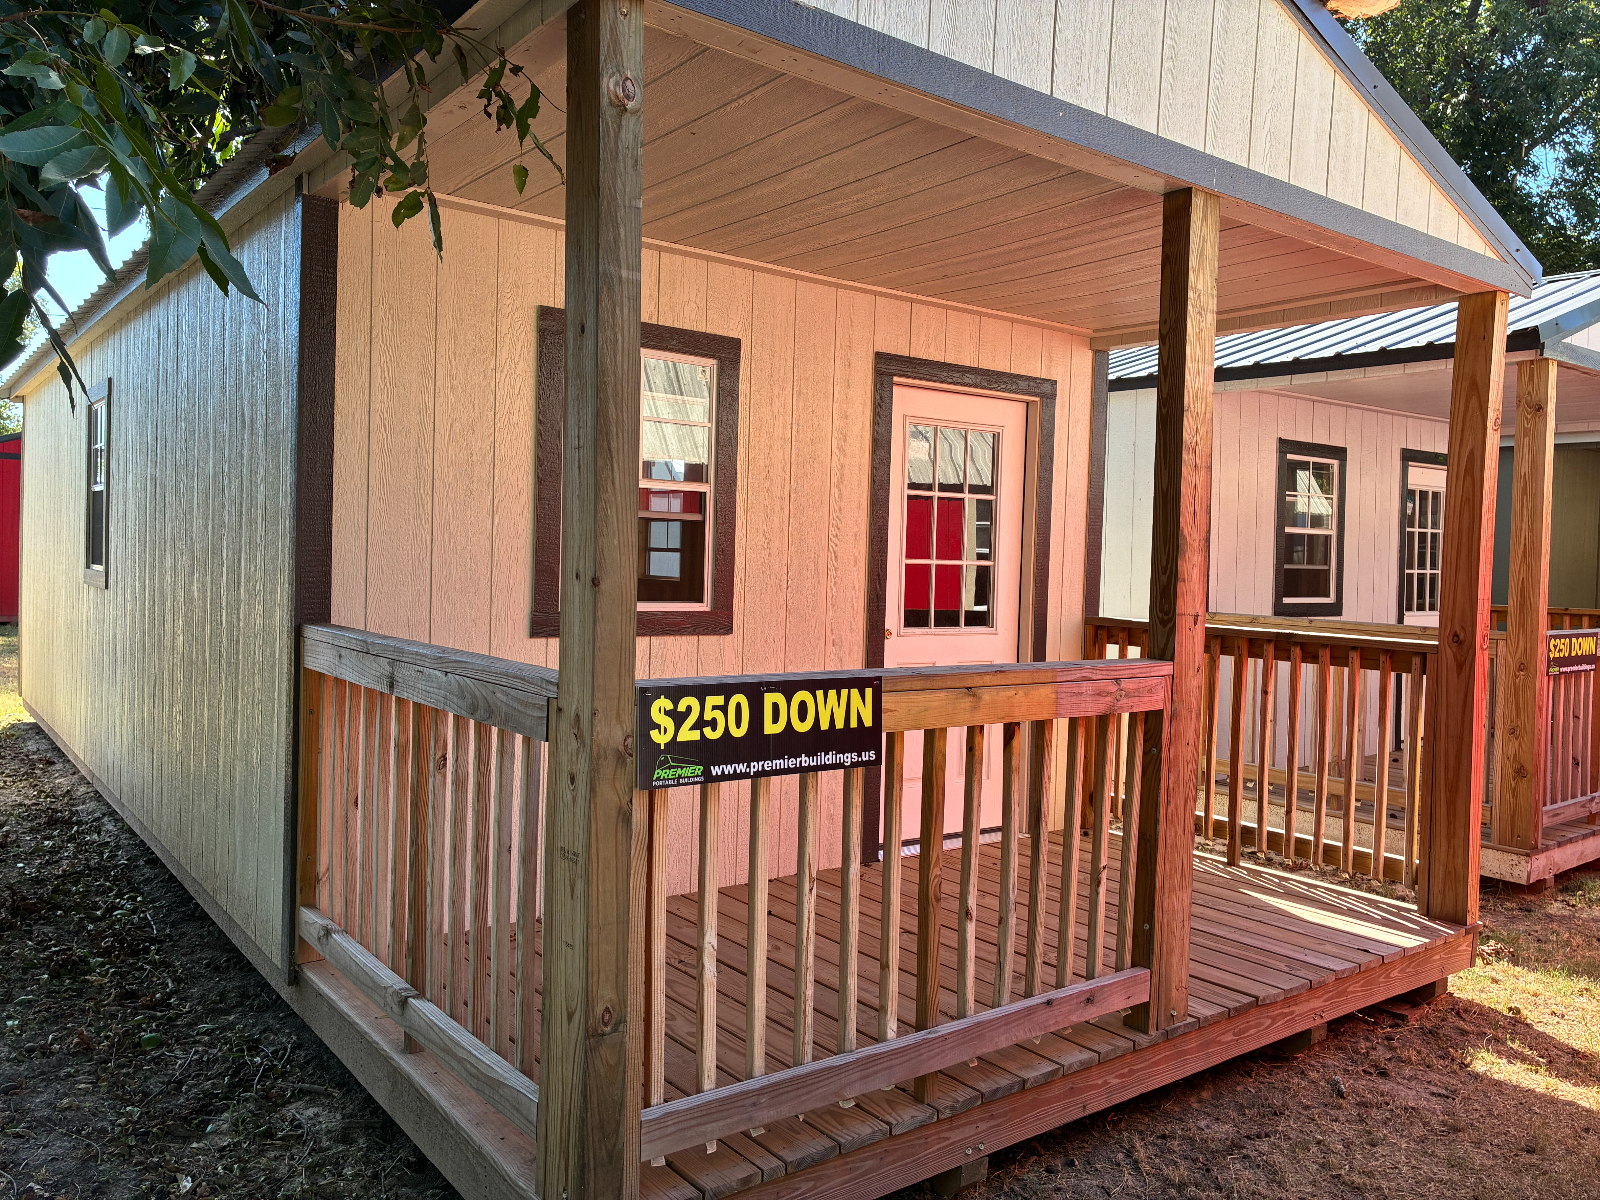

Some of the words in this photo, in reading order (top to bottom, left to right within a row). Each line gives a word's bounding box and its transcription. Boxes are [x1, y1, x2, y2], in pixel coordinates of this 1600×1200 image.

[1549, 638, 1569, 660] $250
[1571, 637, 1596, 656] DOWN
[649, 693, 750, 750] $250
[763, 687, 873, 735] DOWN
[653, 766, 704, 780] PREMIER
[710, 750, 876, 777] www.premierbuildings.us
[652, 779, 678, 787] PORTABLE
[679, 776, 705, 785] BUILDINGS
